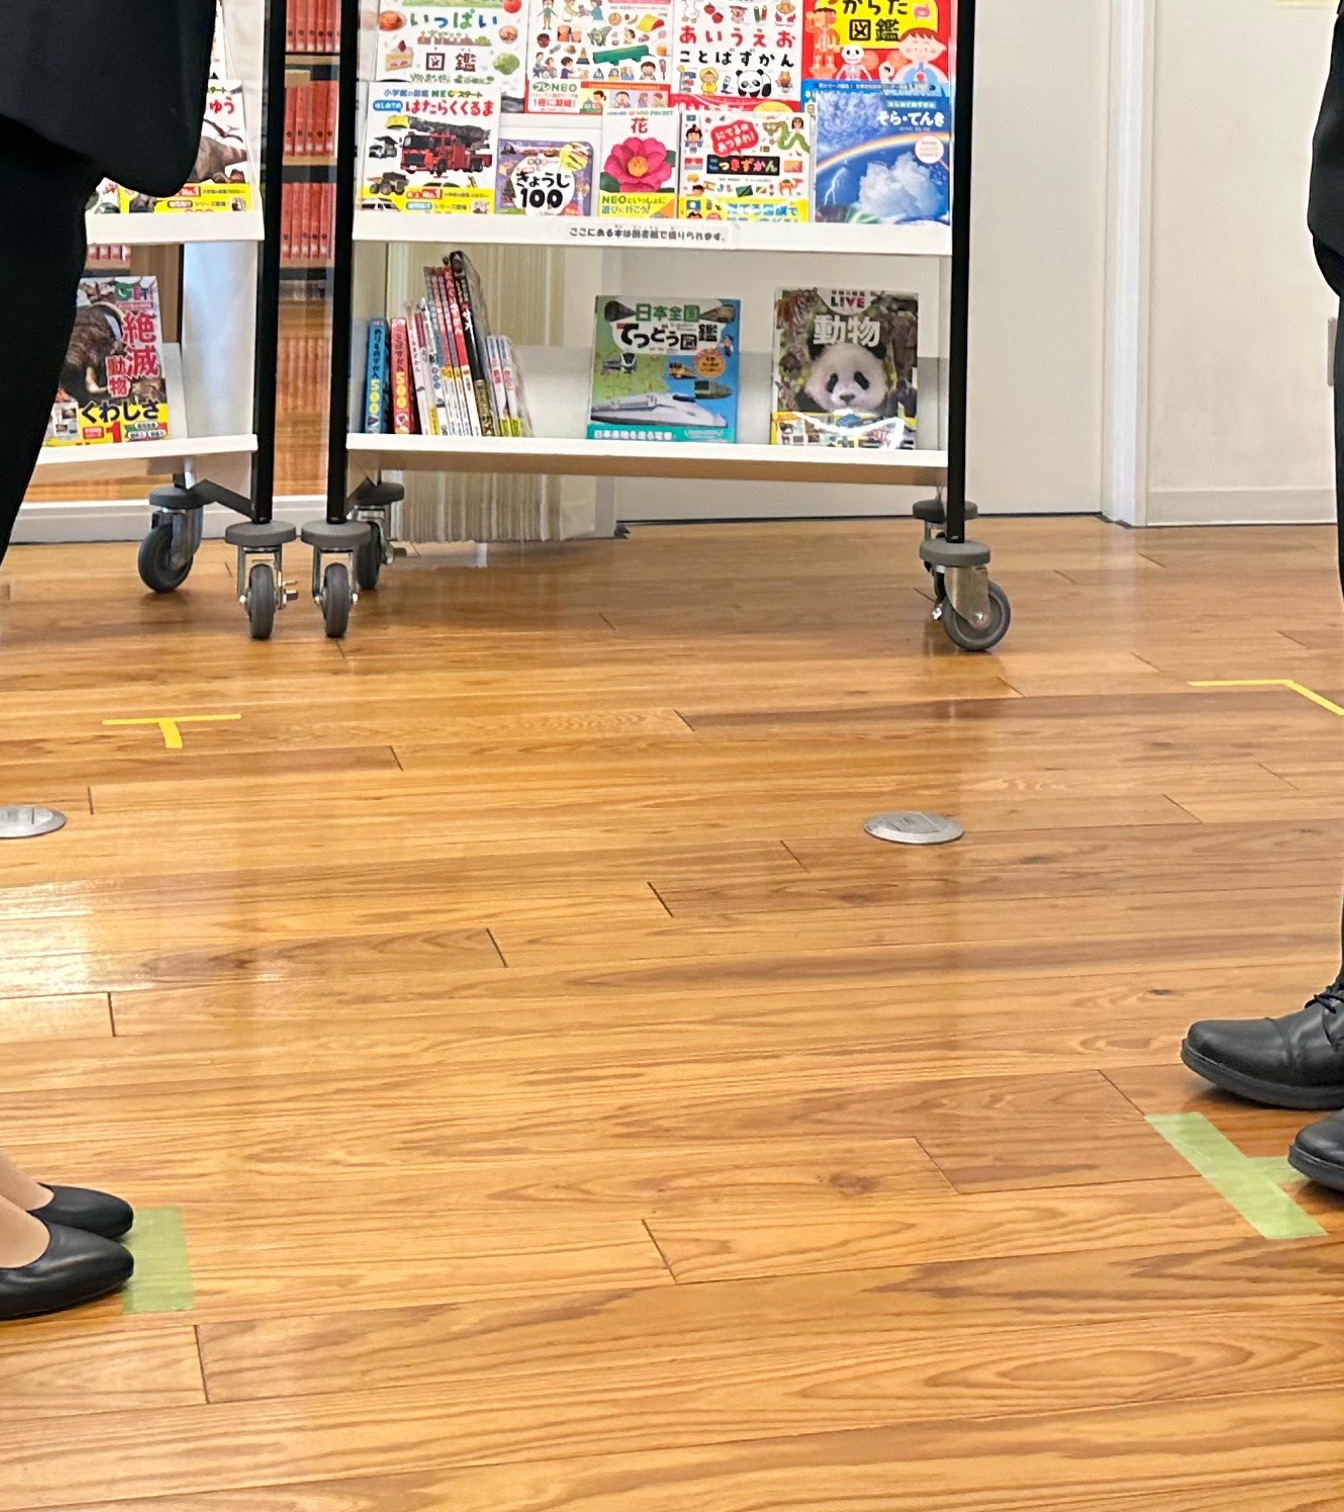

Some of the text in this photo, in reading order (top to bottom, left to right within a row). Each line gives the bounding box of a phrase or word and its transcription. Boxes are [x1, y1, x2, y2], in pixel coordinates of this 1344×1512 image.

[410, 8, 498, 29] いっぱい
[680, 26, 796, 48] あいうえお
[849, 18, 899, 41] 図鑑
[426, 53, 476, 72] 図鑑
[680, 48, 794, 67] ことばずかん
[405, 99, 494, 116] はたらくくるま
[630, 118, 649, 134] 花
[877, 111, 945, 127] そら・てんき
[520, 188, 563, 208] 100
[636, 303, 700, 322] 日本全国
[831, 297, 865, 308] LIVE
[813, 314, 881, 347] 動物
[123, 311, 158, 376] 絶滅
[107, 358, 127, 396] 動物
[81, 401, 159, 423] くわしさ
